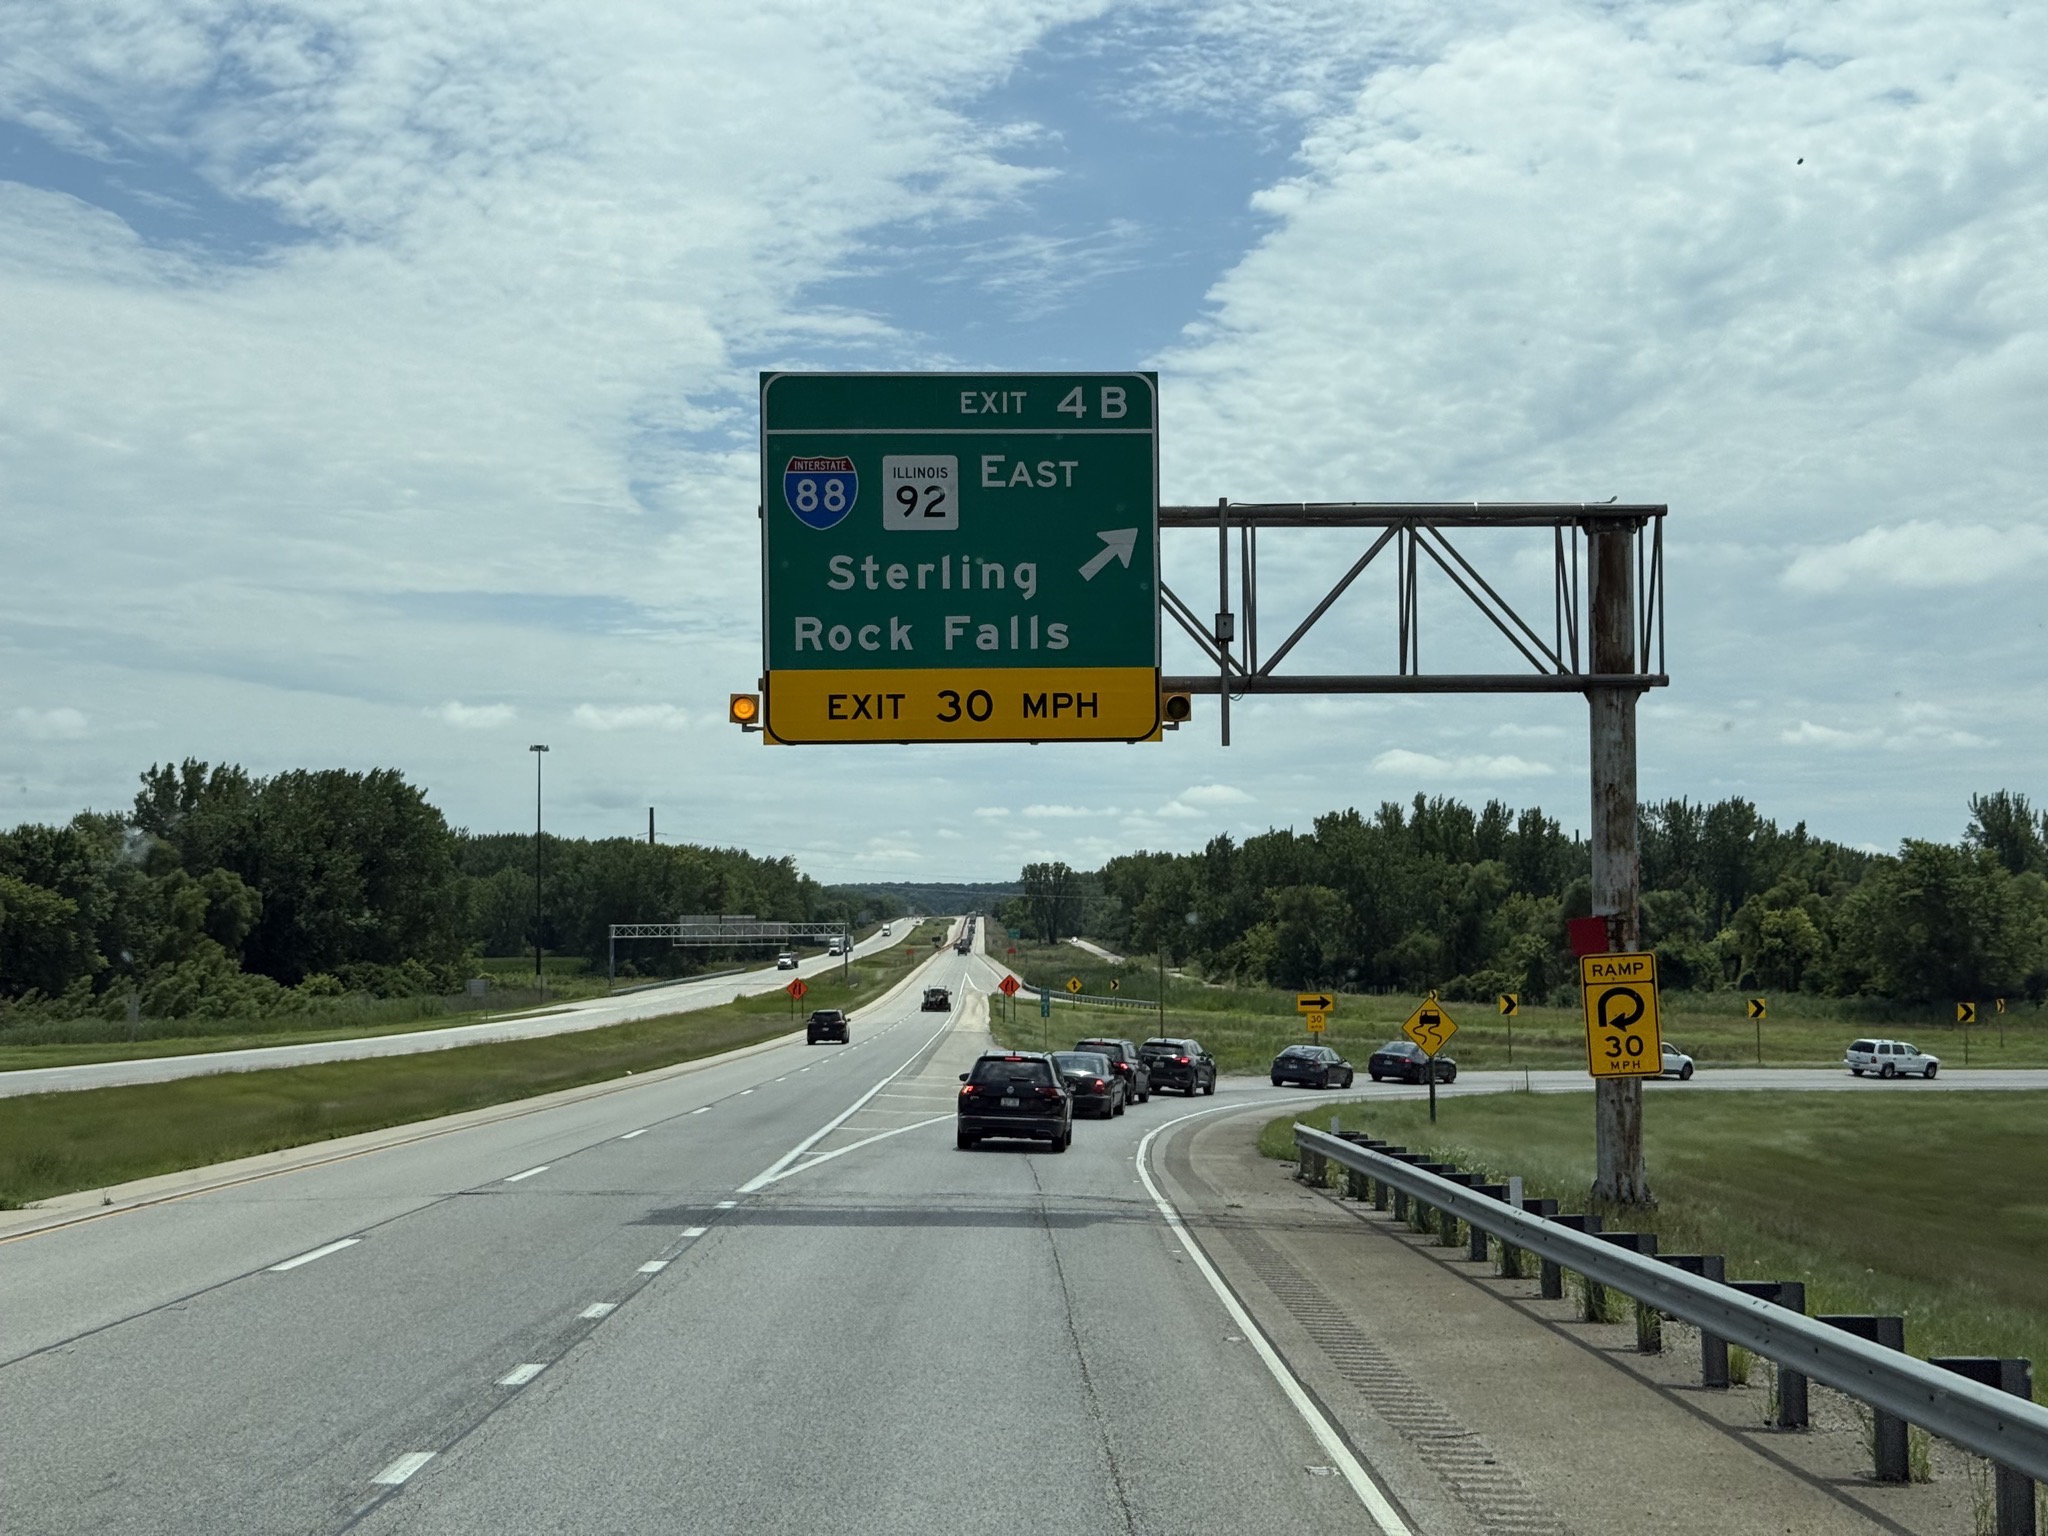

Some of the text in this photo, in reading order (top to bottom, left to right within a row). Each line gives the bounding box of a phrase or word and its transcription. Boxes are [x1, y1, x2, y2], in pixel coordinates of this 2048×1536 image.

[960, 392, 1027, 414] EXIT
[794, 458, 847, 471] INTERSTATE
[893, 467, 948, 479] ILLINOIS
[981, 455, 1078, 487] EAST
[796, 479, 846, 512] 88
[896, 485, 946, 518] 92
[827, 555, 1037, 600] Sterling
[795, 615, 1069, 651] Rock Falls
[828, 689, 1099, 722] EXIT 30 MPH
[1592, 962, 1644, 977] RAMP
[1605, 1035, 1644, 1058] 30
[1611, 1060, 1641, 1071] MPH
